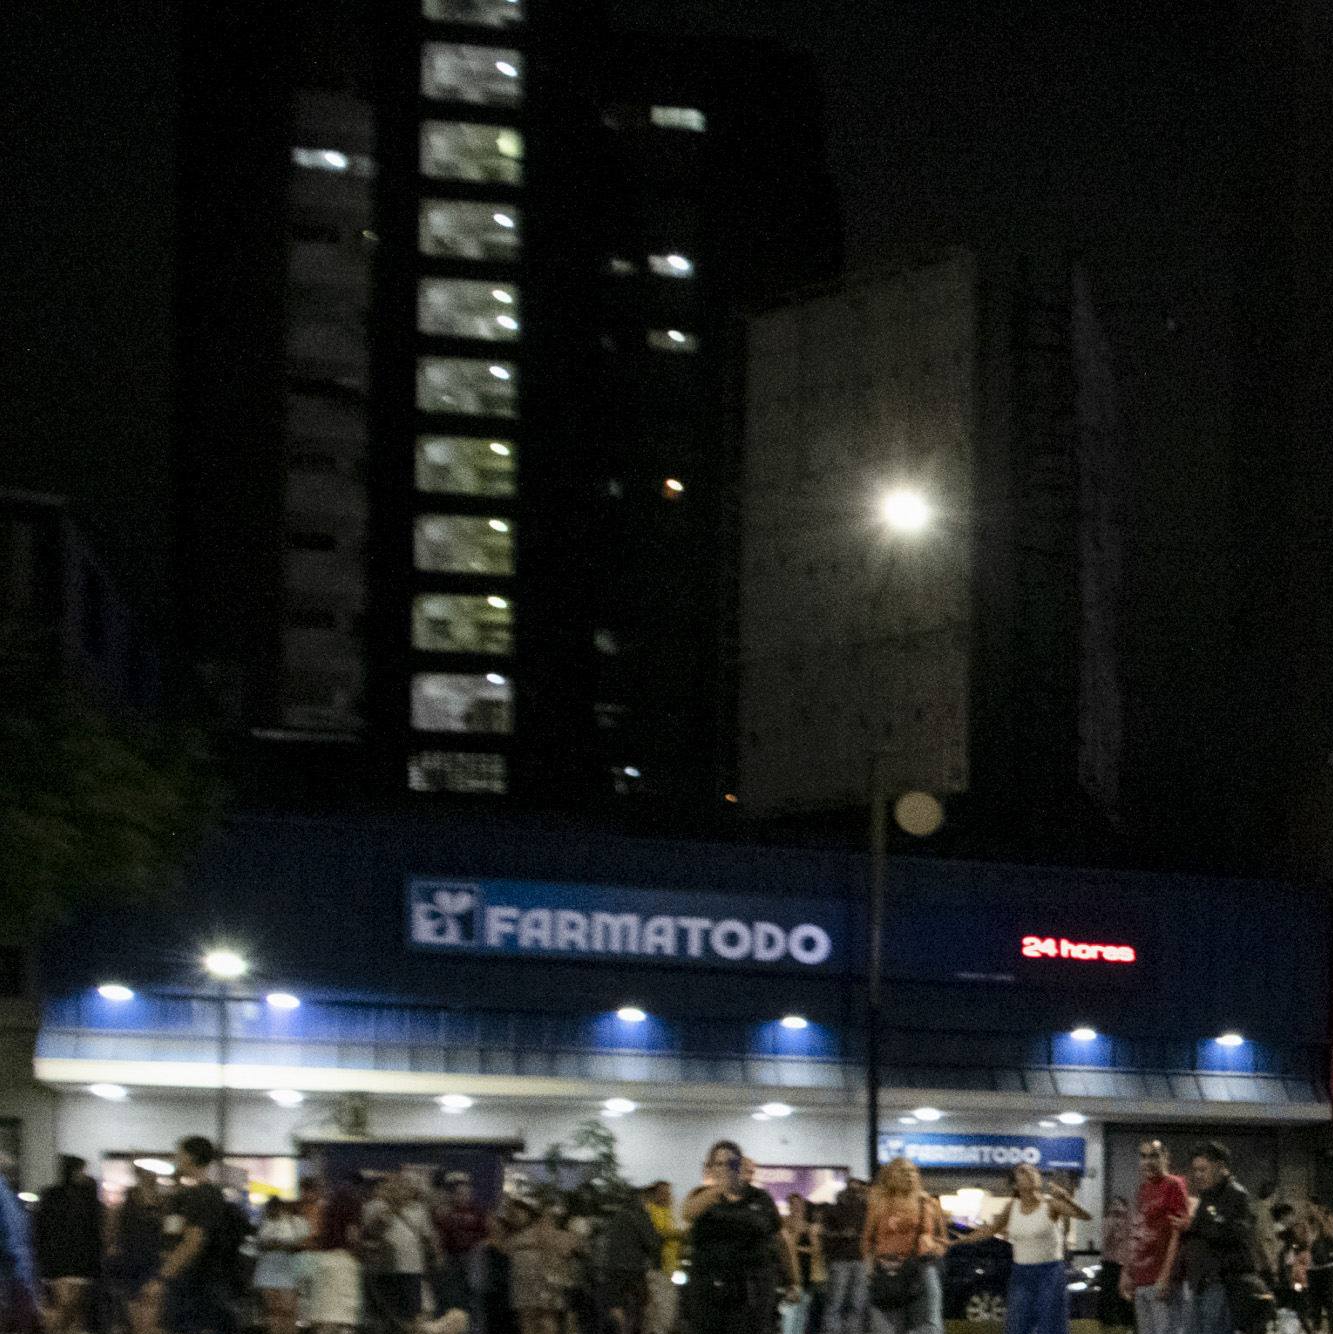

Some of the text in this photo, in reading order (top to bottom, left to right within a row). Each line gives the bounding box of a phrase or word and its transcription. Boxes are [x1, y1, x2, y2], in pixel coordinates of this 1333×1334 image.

[485, 905, 833, 965] FARMATODO
[1022, 935, 1136, 962] 24 horas
